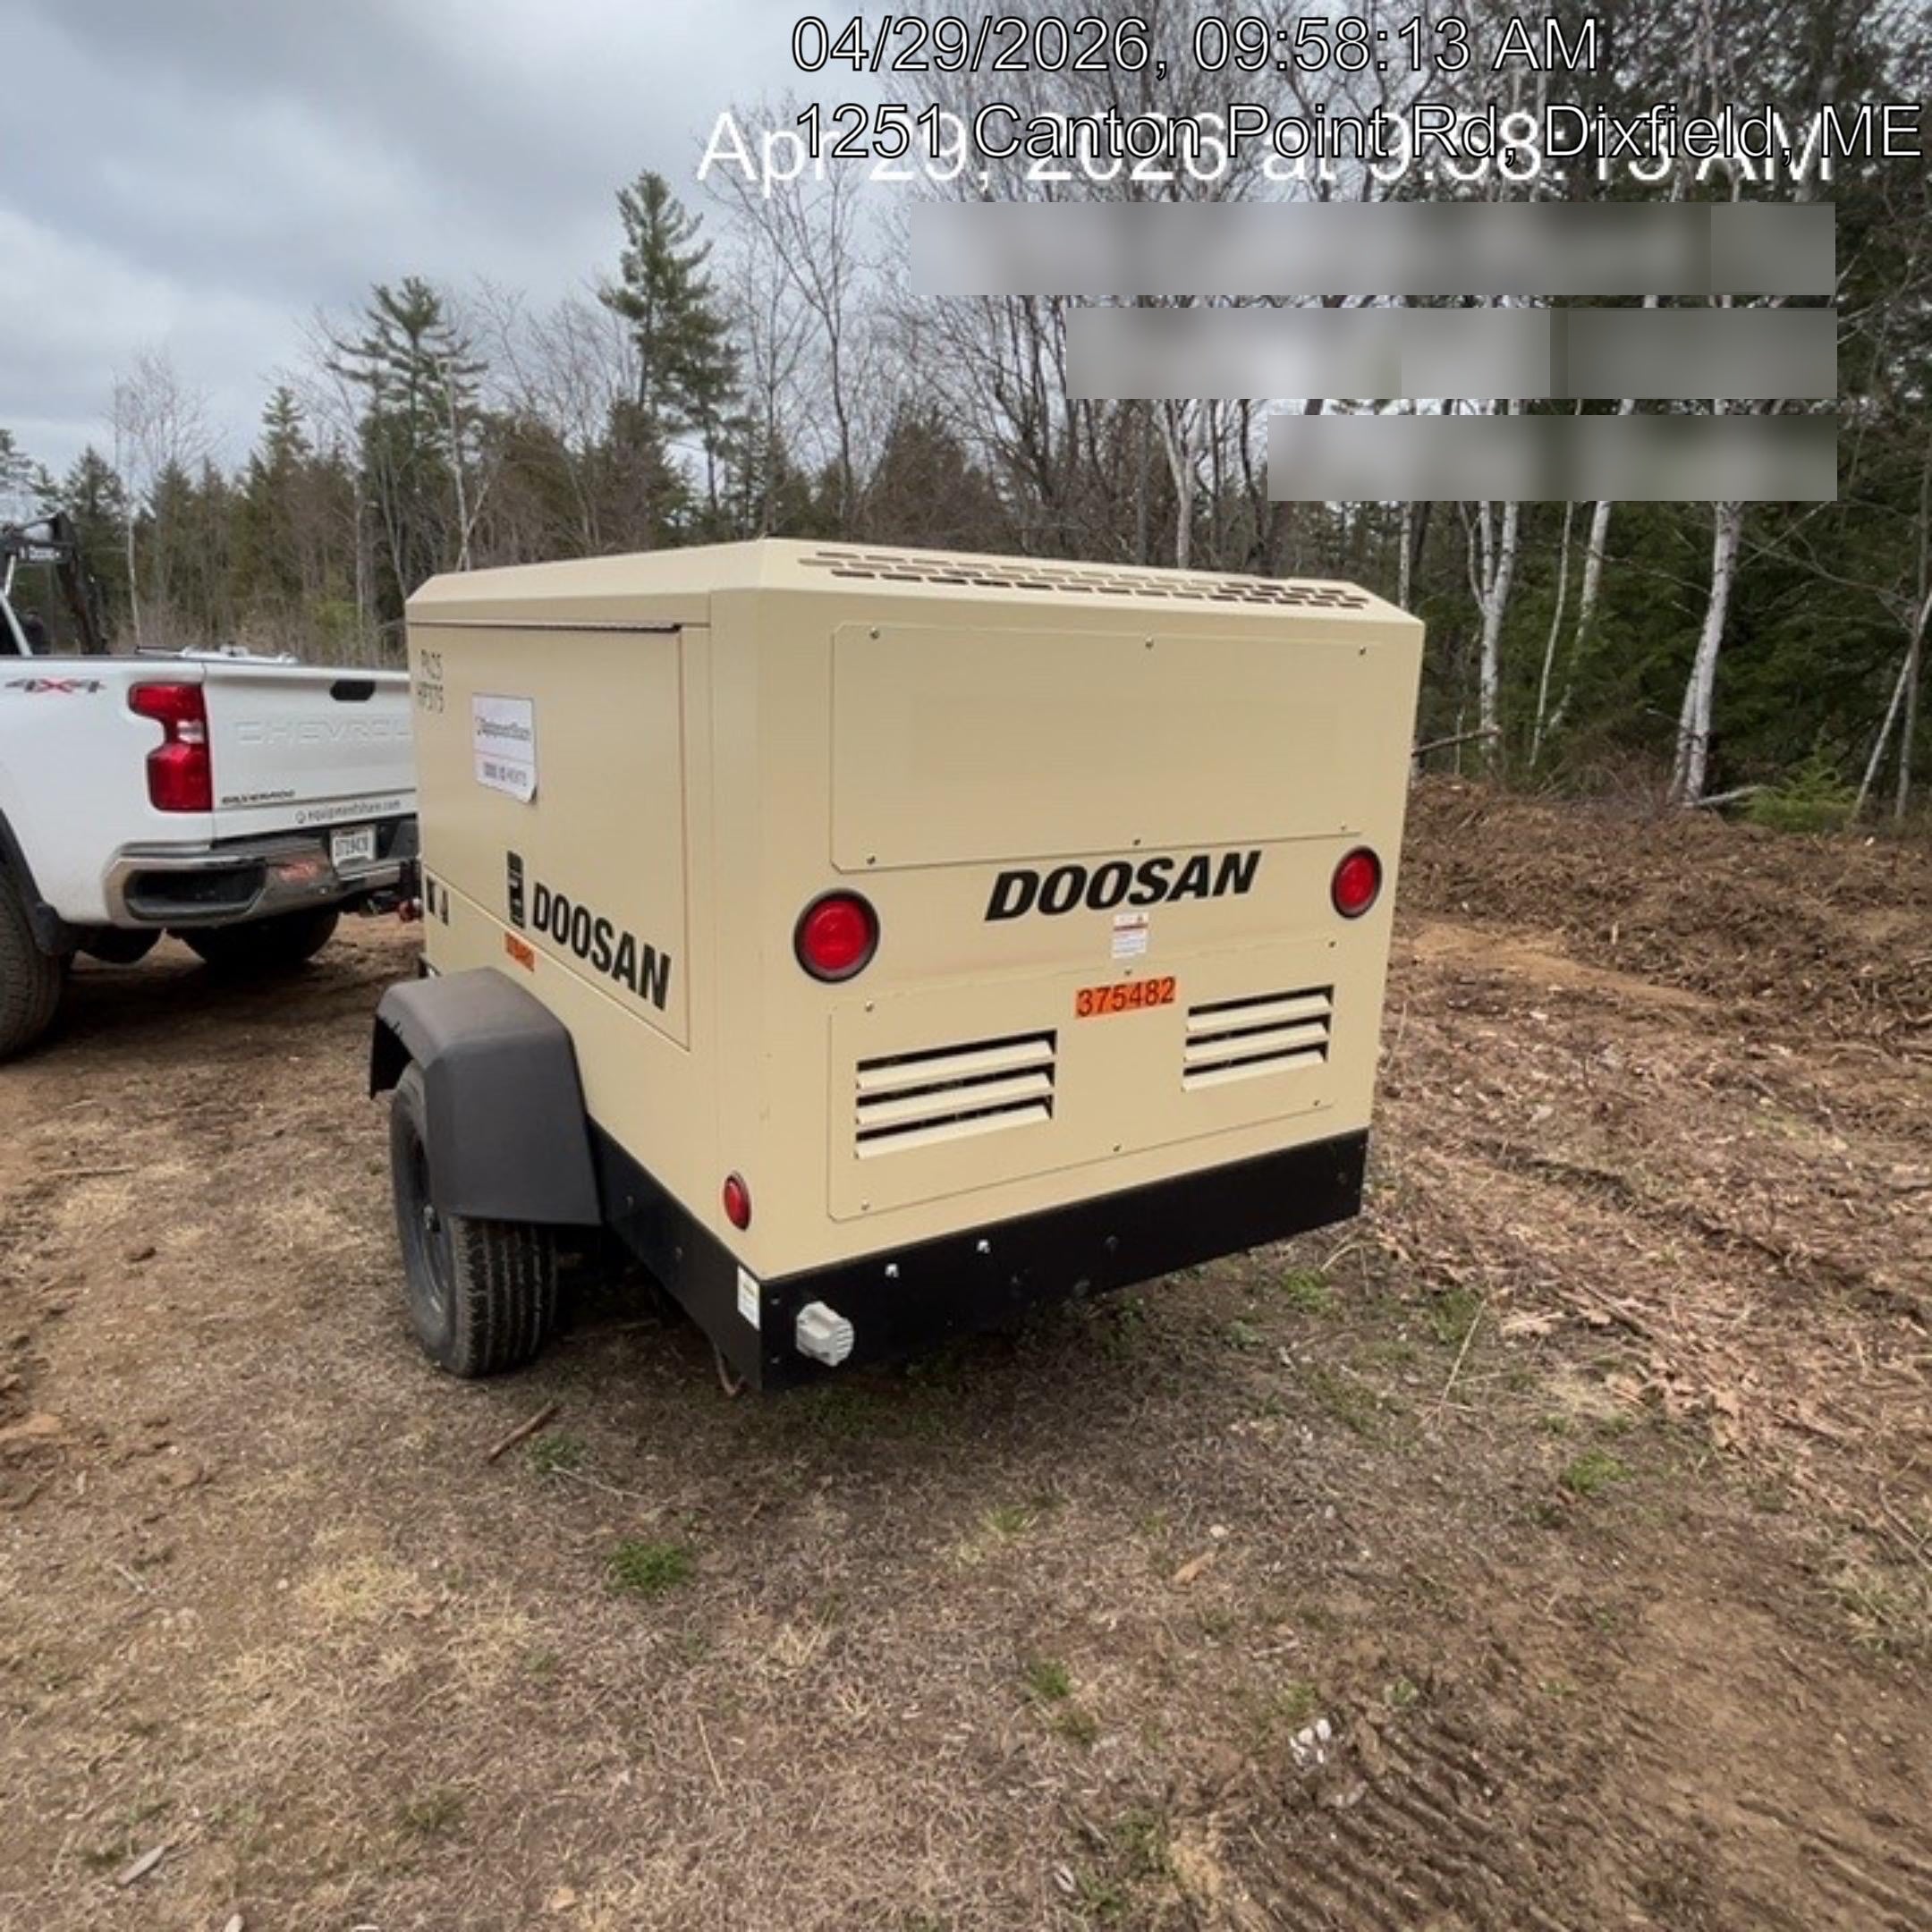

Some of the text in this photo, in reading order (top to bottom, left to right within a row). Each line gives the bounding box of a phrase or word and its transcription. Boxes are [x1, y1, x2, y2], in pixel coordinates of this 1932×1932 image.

[234, 717, 412, 746] CHEVROL
[984, 850, 1262, 922] DOOSAN
[533, 880, 672, 1012] DOOSAN
[1076, 976, 1177, 1017] 375482
